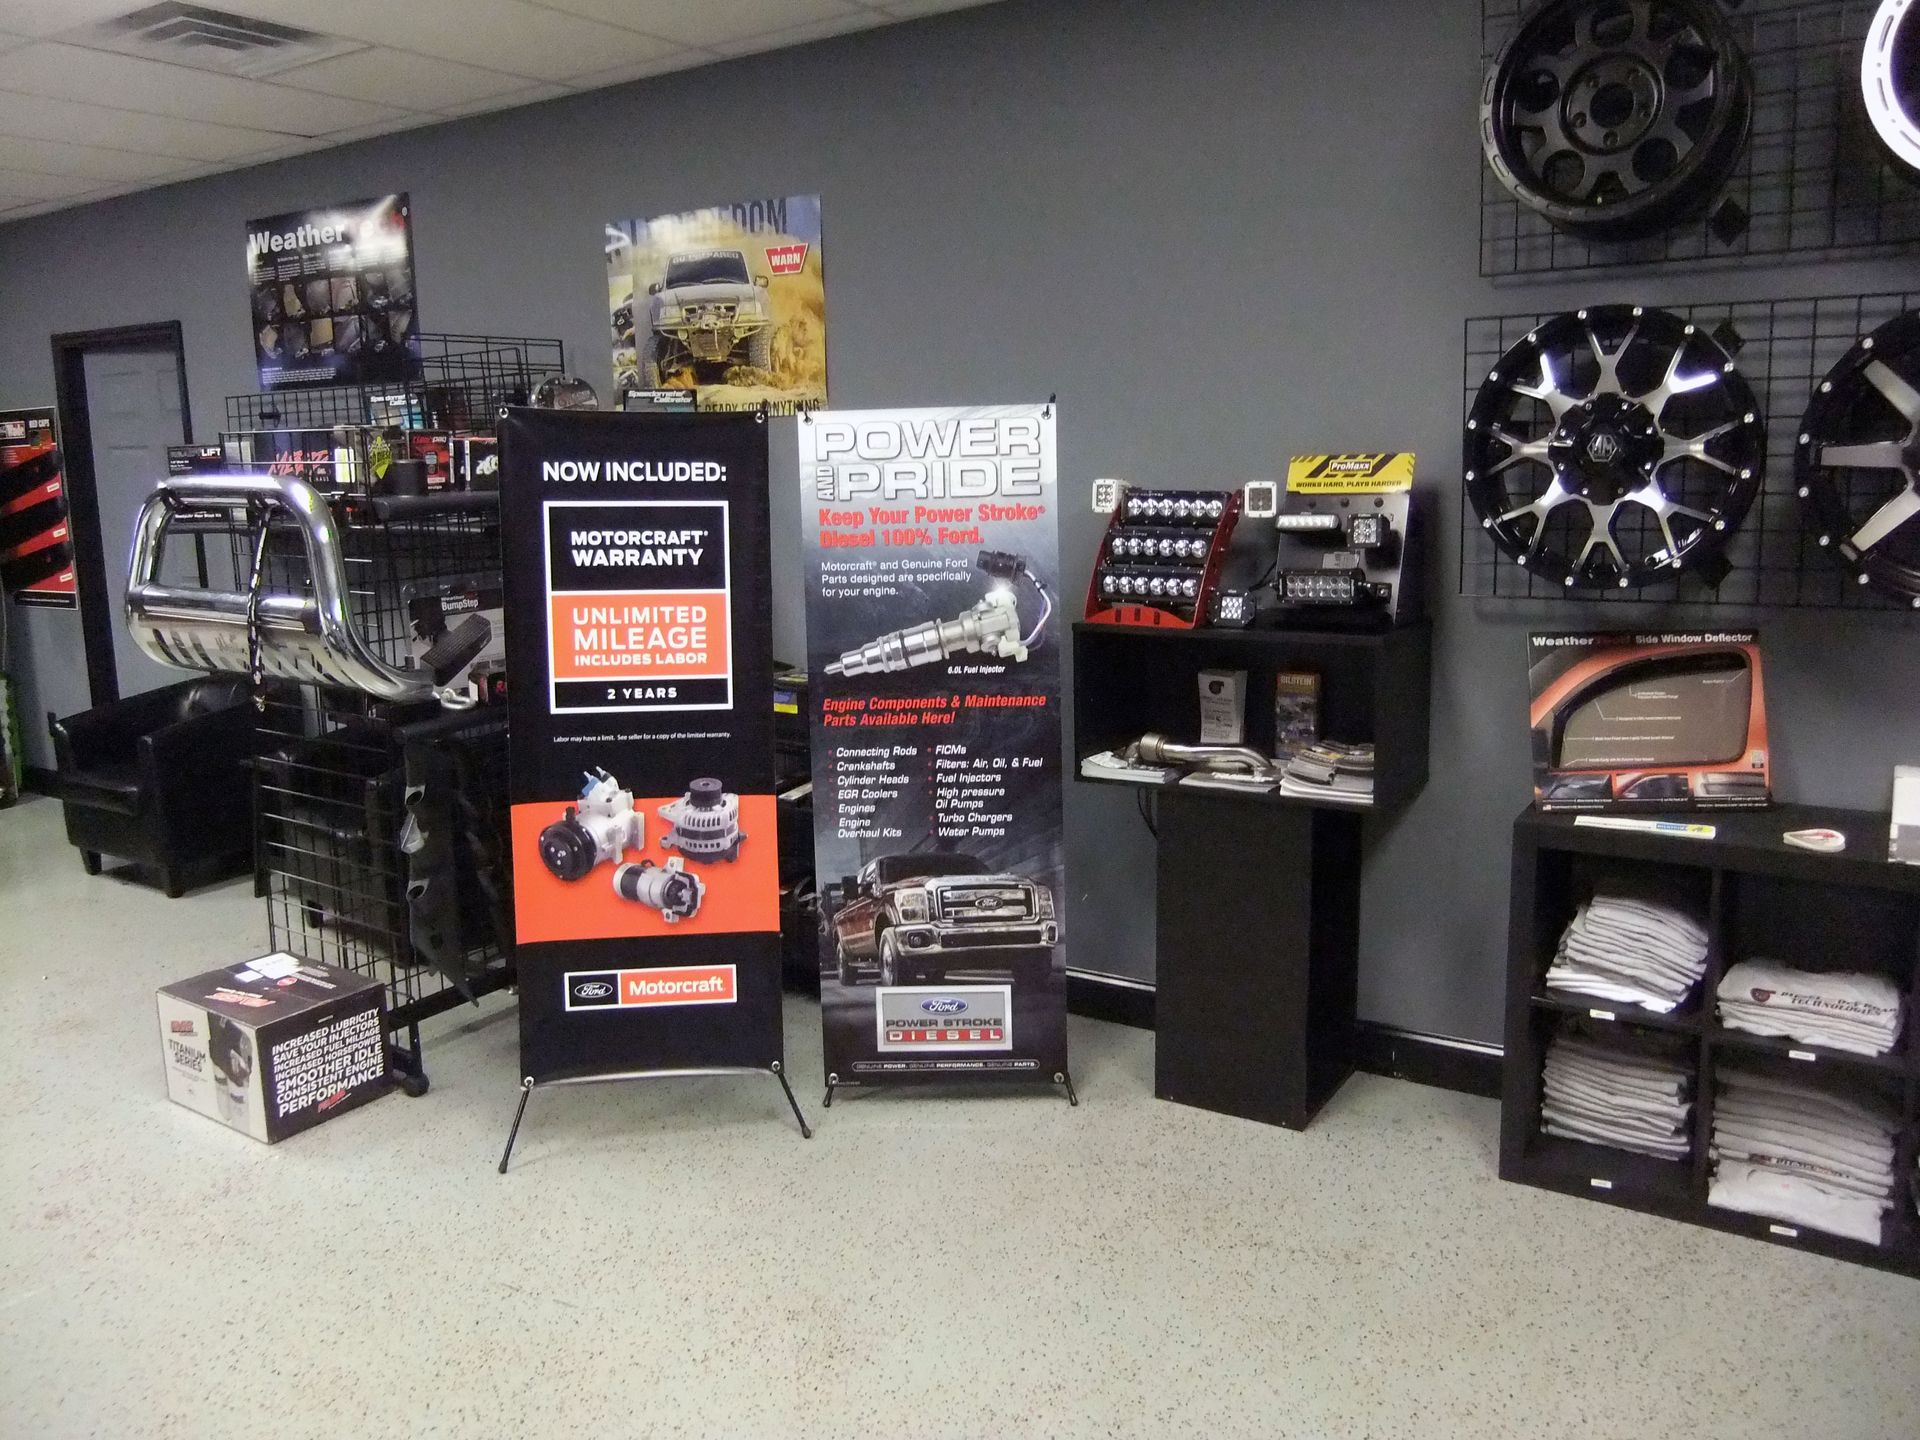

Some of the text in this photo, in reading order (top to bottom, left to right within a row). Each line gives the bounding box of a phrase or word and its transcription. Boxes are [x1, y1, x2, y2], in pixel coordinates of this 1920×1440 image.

[770, 252, 801, 266] WARN
[815, 417, 1040, 462] POWER
[201, 448, 221, 457] LIFT
[543, 461, 727, 482] NOW INCLUDED:
[1331, 461, 1369, 471] ProMaxx
[816, 458, 1042, 501] AND PRIDE
[1323, 481, 1345, 489] HARD,
[818, 507, 864, 529] Keep
[868, 506, 910, 525] Your
[914, 505, 973, 523] Power
[819, 527, 985, 548] Diesel 100% Ford.
[571, 548, 704, 567] WARRANTY
[880, 560, 899, 570] and
[901, 559, 943, 570] Genuine
[945, 559, 968, 568] Ford
[821, 571, 972, 586] Parts designed are specifically
[822, 586, 899, 599] for your engine.
[441, 599, 479, 611] BumpStep
[572, 606, 707, 625] UNLIMITED
[574, 626, 707, 651] MILEAGE
[1635, 635, 1659, 644] Side
[1661, 634, 1703, 644] Window
[1704, 633, 1753, 643] Deflector
[574, 653, 708, 667] INCLUDES LABOR
[947, 665, 1006, 674] 6.0L Fuel Injector
[607, 687, 678, 700] 2 YEARS
[822, 694, 1047, 714] Engine Components & Maintenance
[824, 711, 956, 727] Parts Available Here!
[836, 746, 918, 759] Connecting Rods
[935, 745, 967, 755] FICMs
[837, 761, 896, 771] Crankshafts
[935, 757, 1043, 770] Filters: Air, Oil, & Fuel
[837, 775, 910, 787] Cylinder Heads
[936, 773, 1001, 783] Fuel Injectors
[837, 789, 898, 799] EGR Coolers
[936, 787, 1005, 799] High pressure
[838, 803, 876, 815] Engines
[935, 799, 984, 810] Oil Pumps
[839, 818, 871, 829] Engine
[938, 813, 1013, 824] Turbo Chargers
[837, 828, 902, 838] Overhaul Kits
[938, 827, 1005, 838] Water Pumps
[629, 976, 723, 996] Motorcraft
[929, 999, 959, 1013] Ford
[886, 1017, 1003, 1028] POWER STROKE
[272, 1007, 380, 1056] INCREASED LUBRICITY
[889, 1031, 1001, 1041] DIESEL
[273, 1017, 380, 1065] SAVE YOUR INJECTORS
[168, 1038, 206, 1060] TITANIUM
[274, 1025, 381, 1074] INCREASED FUEL MILEAGE
[174, 1051, 203, 1073] SERIES
[275, 1034, 382, 1082] INCREASED HORSEPOWER
[276, 1042, 383, 1095] SMOOTHER IDLE
[276, 1068, 346, 1105] CONSISTENT
[345, 1053, 384, 1077] ENGINE
[279, 1062, 385, 1118] PERFORMANCE
